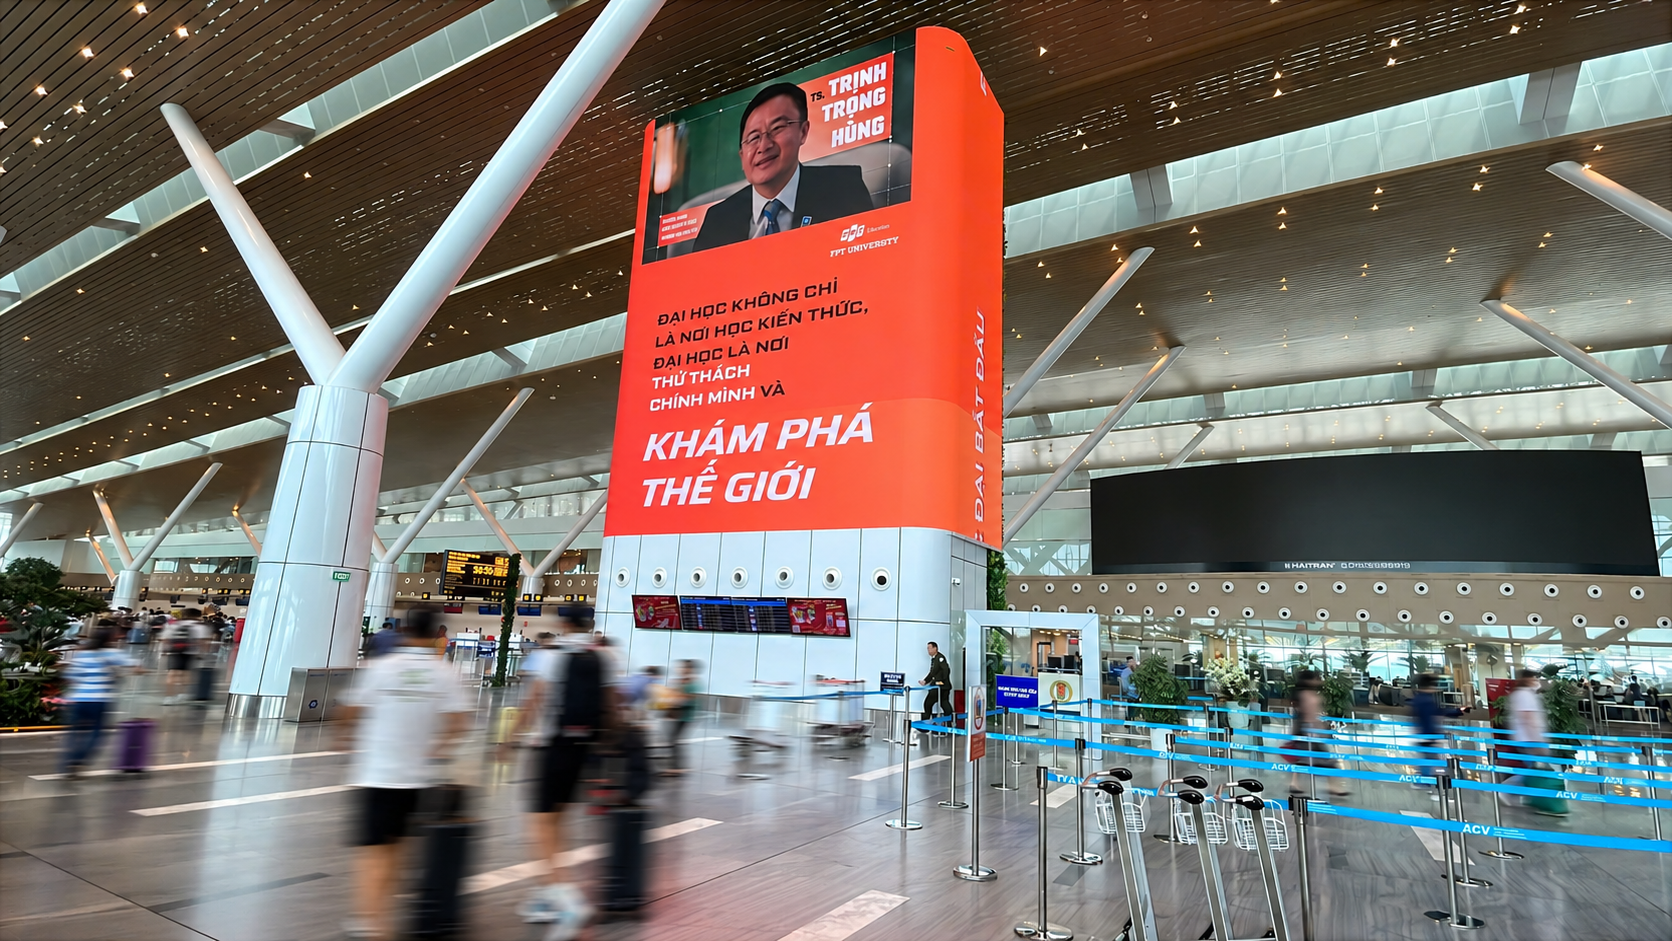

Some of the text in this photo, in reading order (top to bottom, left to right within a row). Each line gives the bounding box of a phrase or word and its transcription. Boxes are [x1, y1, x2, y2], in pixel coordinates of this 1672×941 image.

[810, 61, 887, 102] TS. TRỊNH
[821, 86, 886, 123] TRỌNG
[655, 299, 869, 348] LÀ NƠI HỌC KIẾN THỨC,
[657, 310, 686, 327] ĐẠI
[690, 302, 727, 320] HỌC
[731, 288, 799, 313] KHÔNG
[653, 336, 789, 370] ĐẠI HỌC LÀ NƠI
[651, 363, 751, 389] THỬ THÁCH
[649, 392, 703, 412] CHÍNH
[760, 380, 786, 398] VÀ
[642, 401, 874, 462] KHÁM PHÁ
[642, 458, 817, 508] THẾ GIỚI
[1556, 791, 1578, 799] ACV
[1462, 824, 1490, 835] ACV
